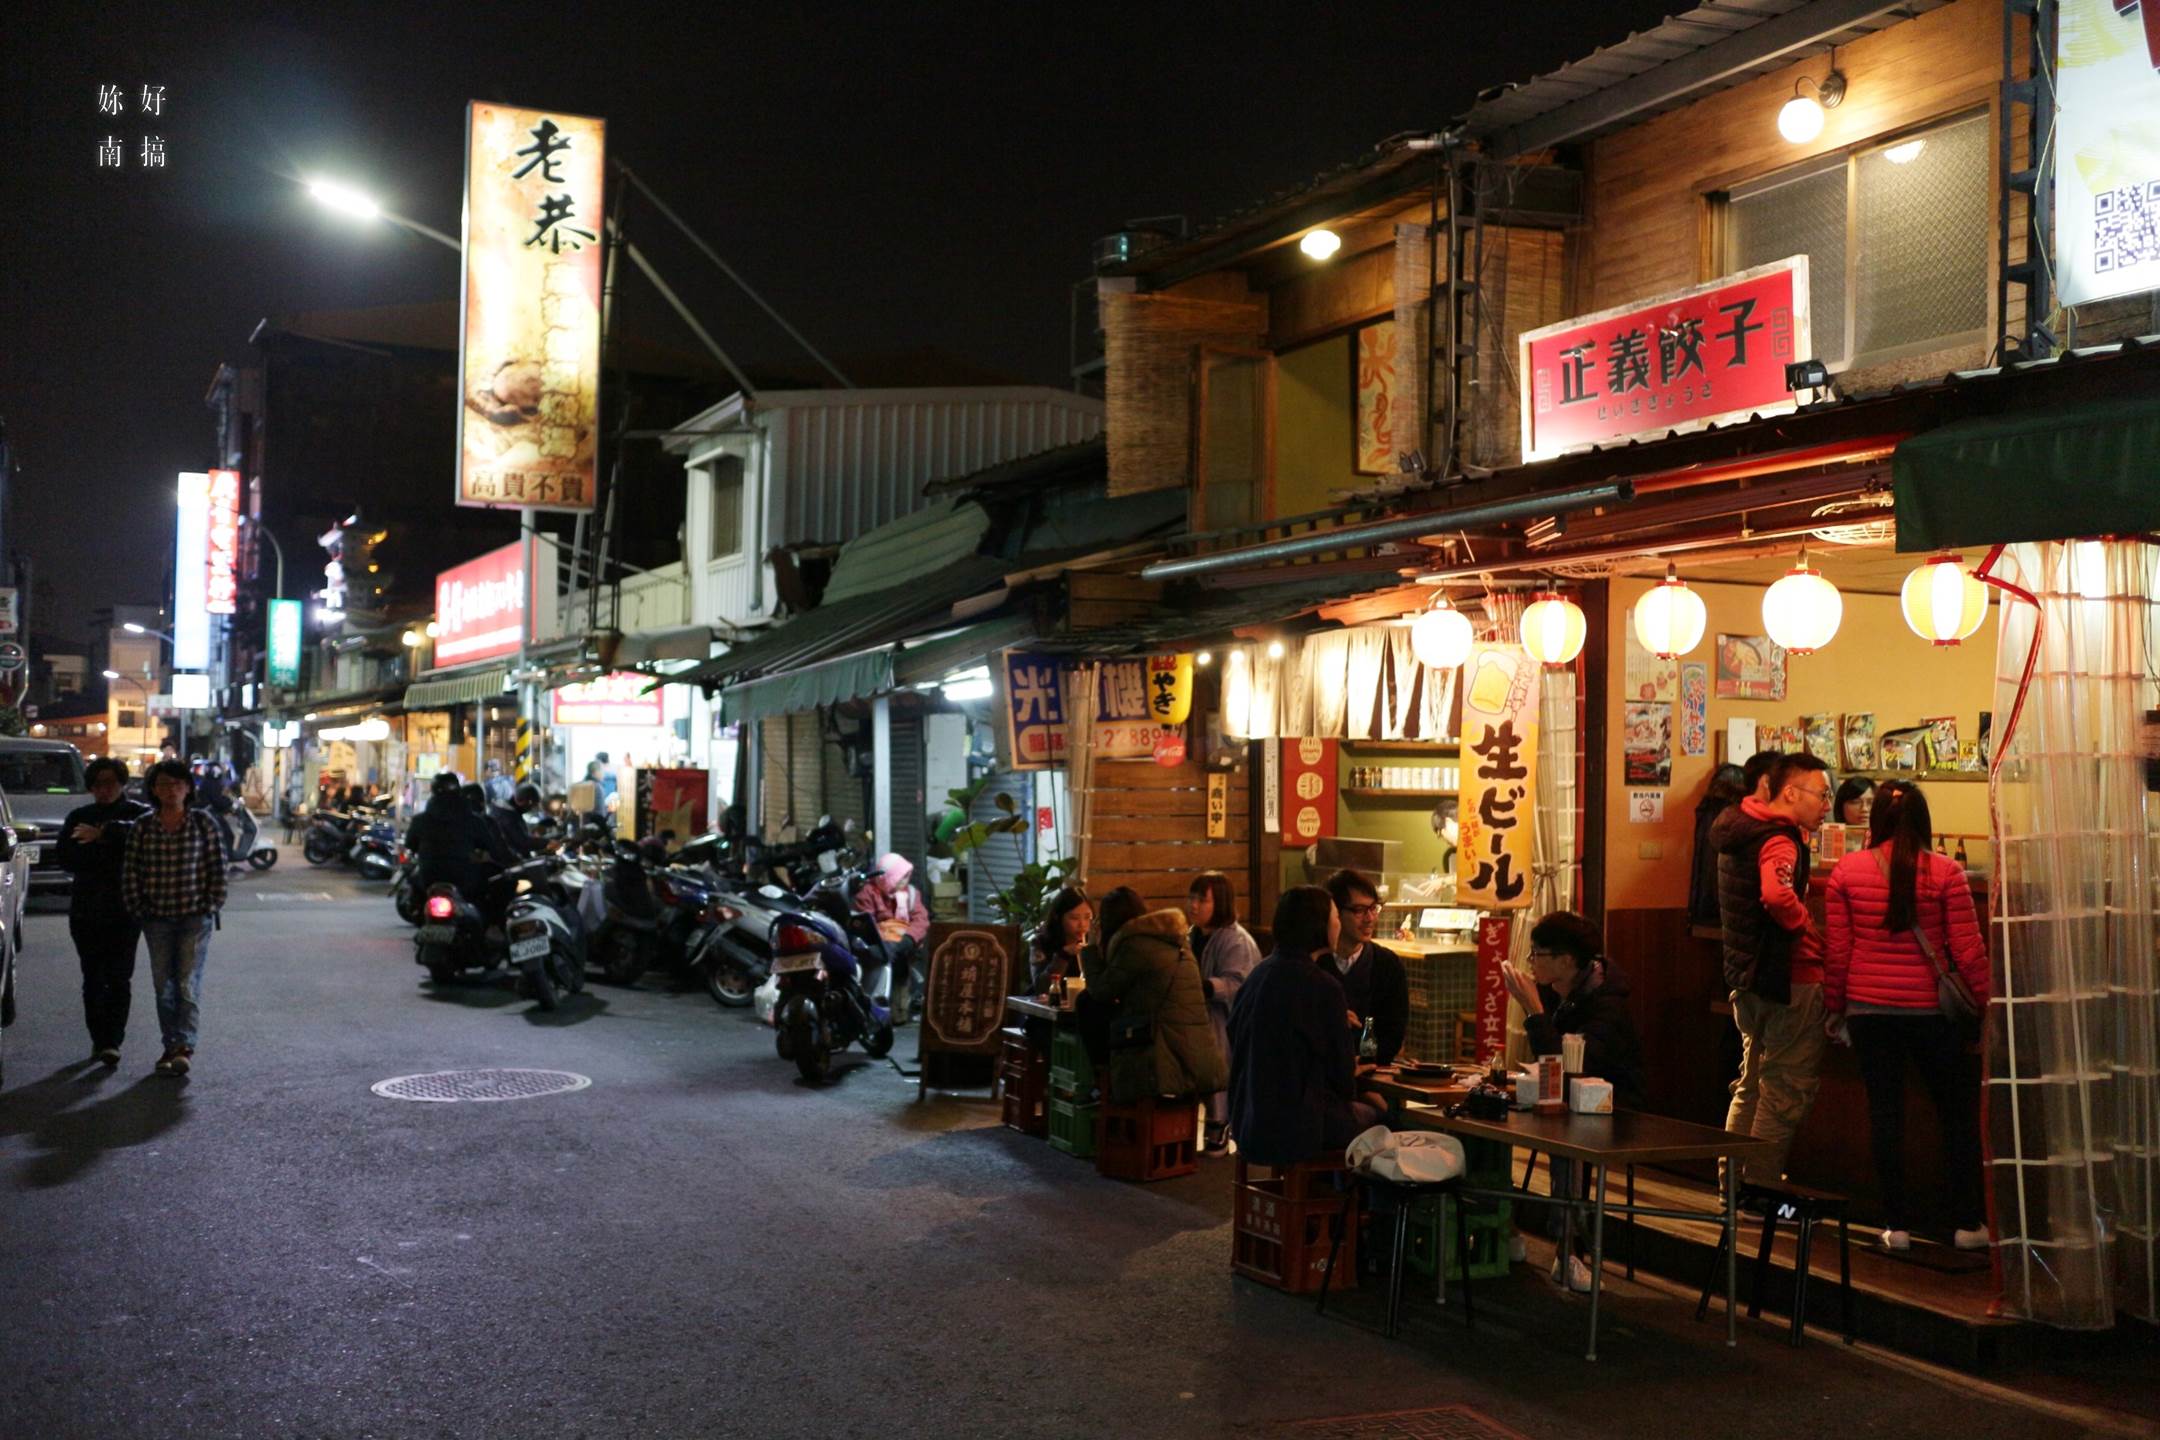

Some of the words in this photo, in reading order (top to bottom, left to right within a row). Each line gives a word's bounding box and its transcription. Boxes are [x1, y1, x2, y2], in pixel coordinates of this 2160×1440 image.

[1558, 297, 1764, 405] 正義餃子
[470, 472, 585, 501] 高貴不貴
[1466, 719, 1528, 902] 生ビール
